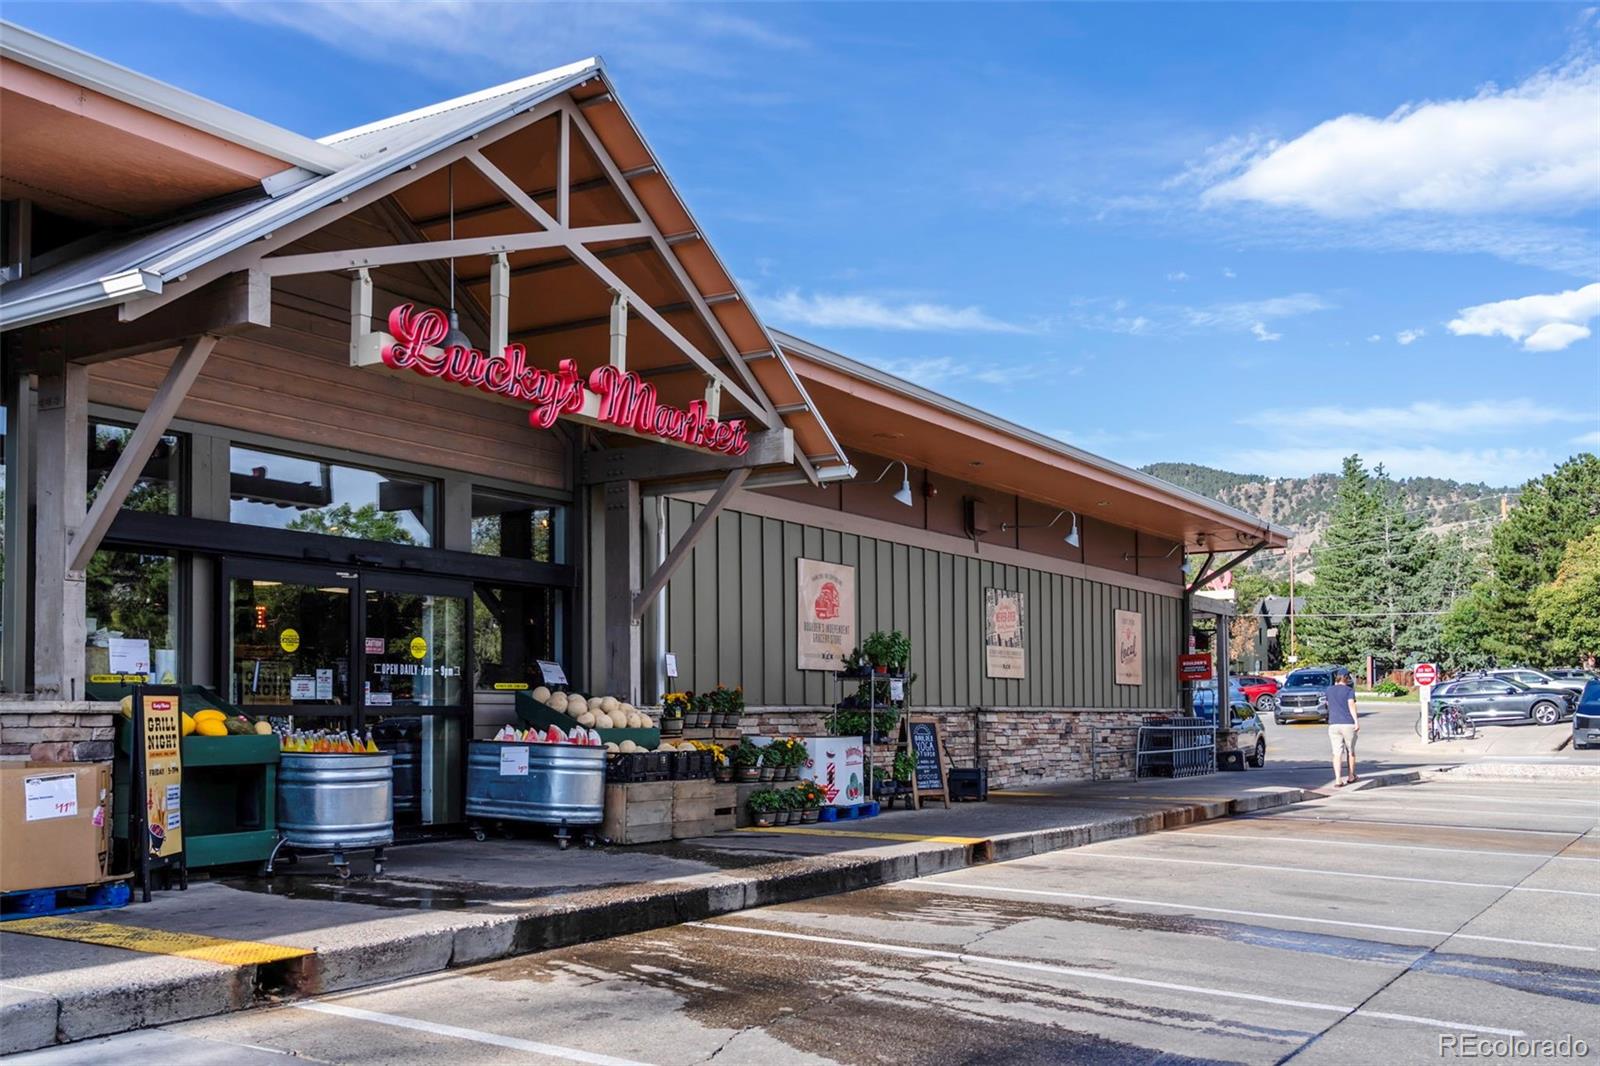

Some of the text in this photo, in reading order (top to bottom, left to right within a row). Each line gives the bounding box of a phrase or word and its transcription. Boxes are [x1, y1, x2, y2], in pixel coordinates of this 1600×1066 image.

[382, 303, 750, 456] Lucky's Market
[826, 624, 850, 635] INDEPENDENT
[382, 664, 398, 675] OPEN
[400, 664, 418, 675] DAILY
[421, 665, 432, 675] 7am
[440, 665, 454, 678] 9pm
[148, 717, 176, 732] GRILL
[148, 734, 177, 750] NIGHT
[915, 741, 935, 752] YOGA
[149, 767, 165, 777] FRIDAY
